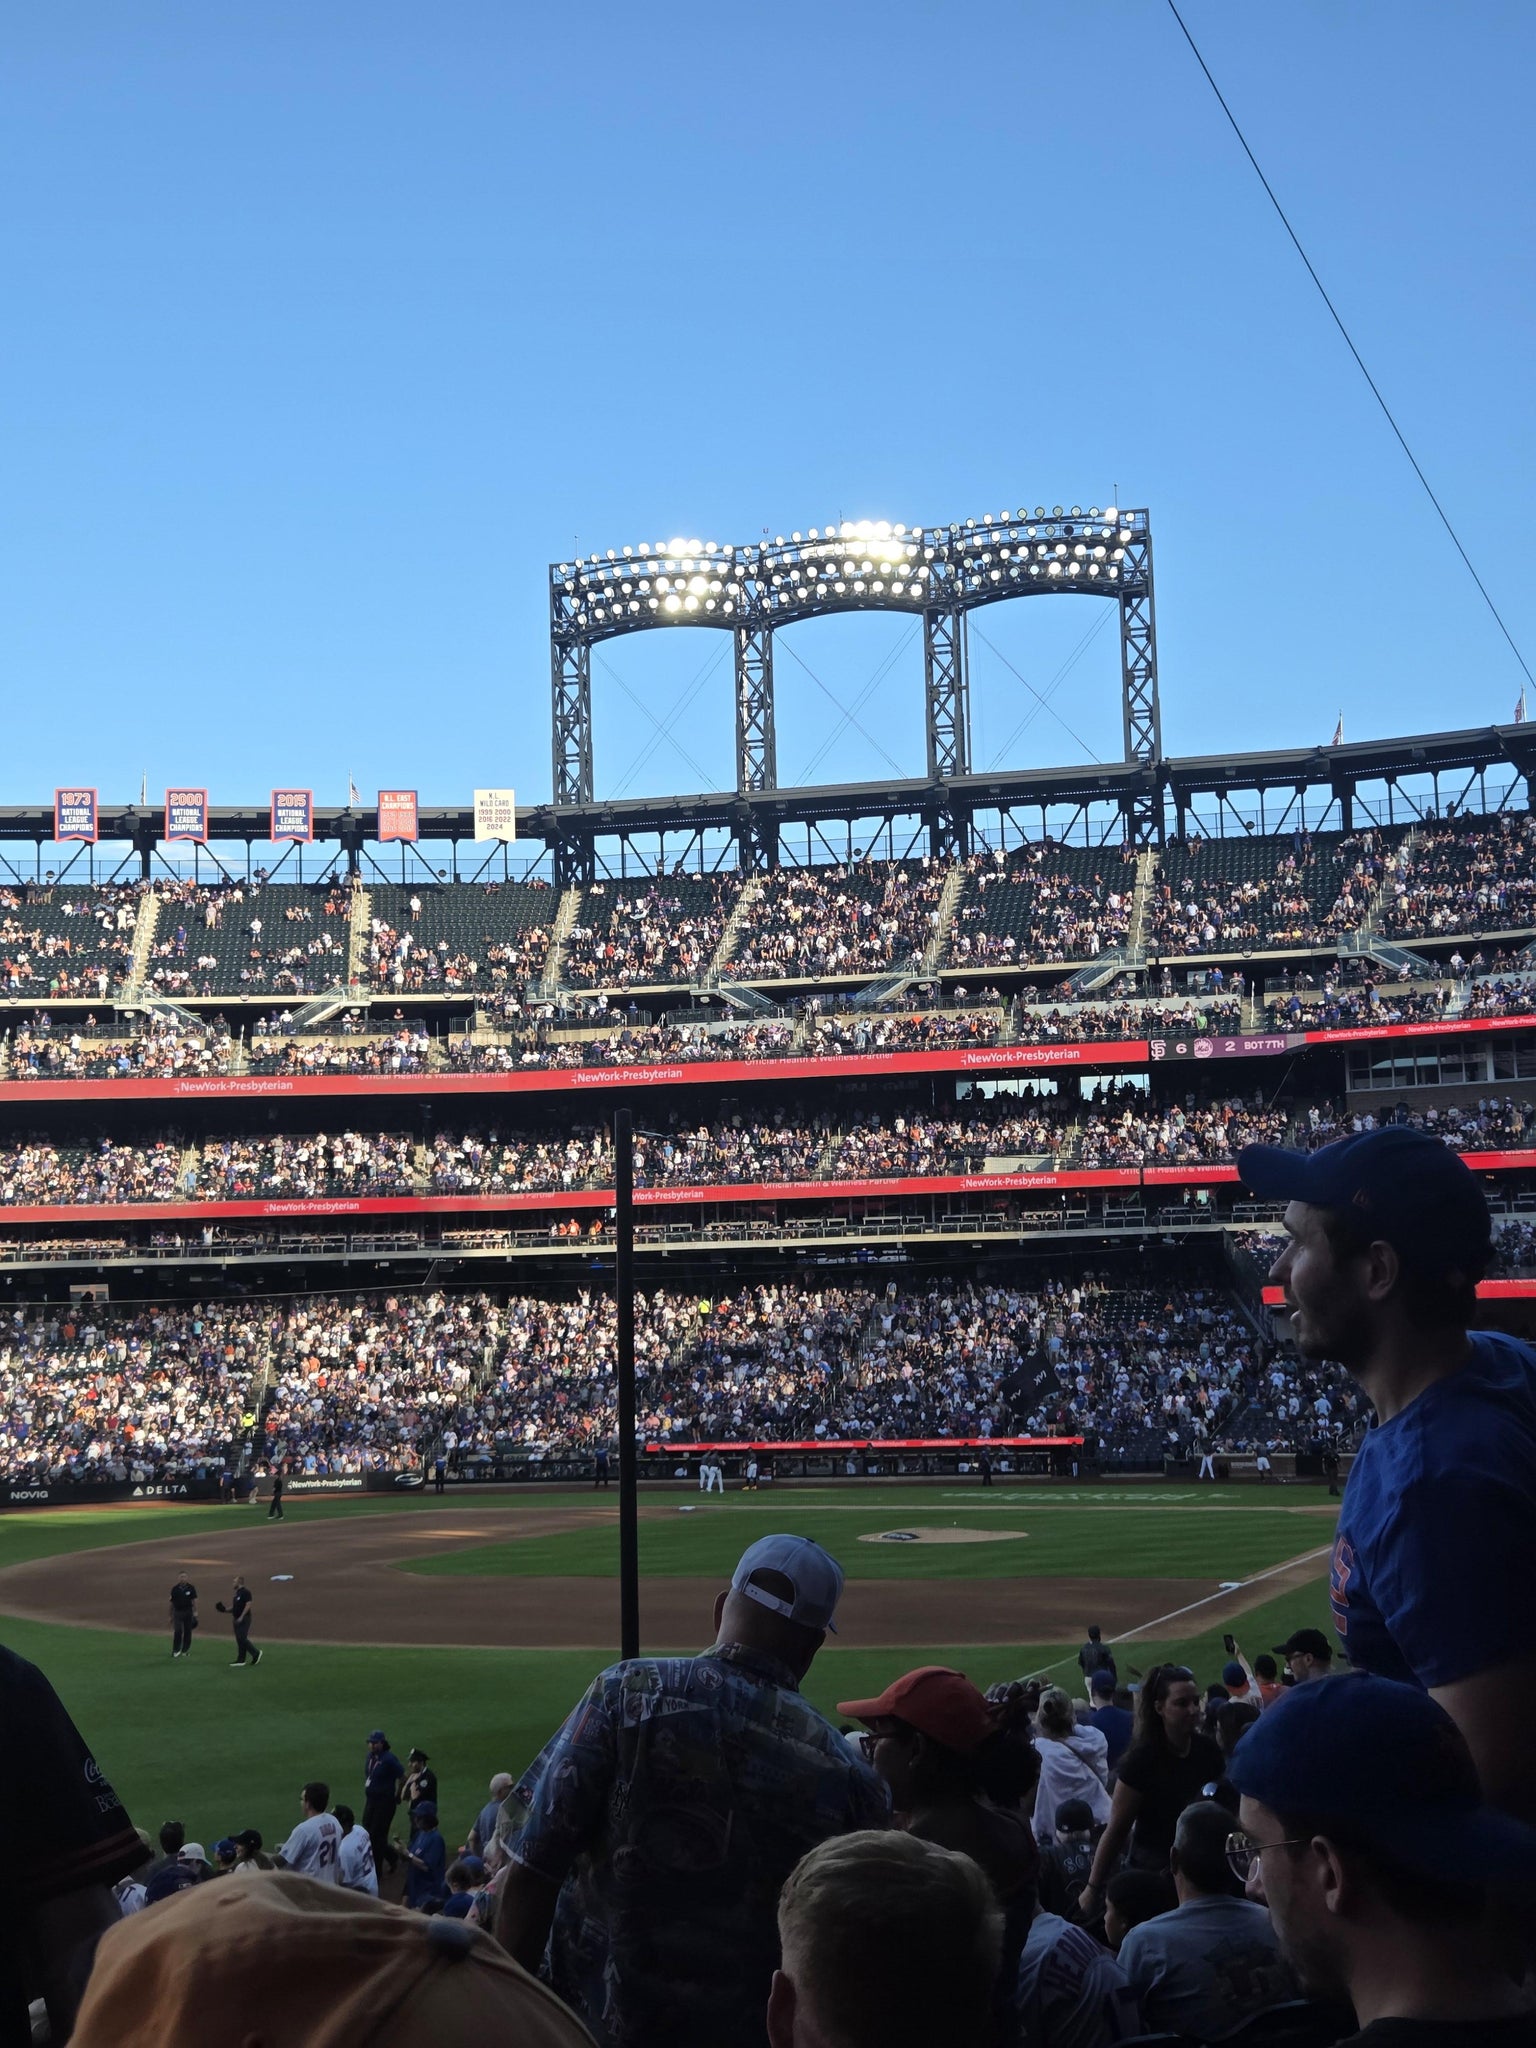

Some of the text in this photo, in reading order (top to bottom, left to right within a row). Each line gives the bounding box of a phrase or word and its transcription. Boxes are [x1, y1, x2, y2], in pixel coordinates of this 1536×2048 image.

[61, 792, 91, 806] 1973
[170, 793, 203, 806] 2000
[278, 794, 306, 807] 2015
[61, 808, 92, 816] NATIONAL
[175, 816, 198, 824] LEAGUE
[60, 824, 94, 832] CHAMPIONS
[170, 824, 204, 832] CHAMPIONS
[276, 824, 308, 832] CHAMPIONS
[1176, 1043, 1188, 1054] 6
[1225, 1040, 1236, 1052] 2
[1244, 1041, 1263, 1050] BOT
[1265, 1040, 1284, 1050] 7TH
[968, 1048, 1080, 1064] NewYork-Presbyterian
[578, 1068, 682, 1082] NewYork-Presbyterian
[180, 1080, 294, 1093] NewYork-Presbyterian
[965, 1176, 1057, 1187] NewYork-Presbyterian
[269, 1202, 360, 1212] NewYork-Presbyterian
[292, 1478, 362, 1489] NewYork-Presbyterian
[10, 1490, 49, 1500] NOVIG
[146, 1484, 188, 1495] DELTA
[320, 1838, 336, 1868] 21
